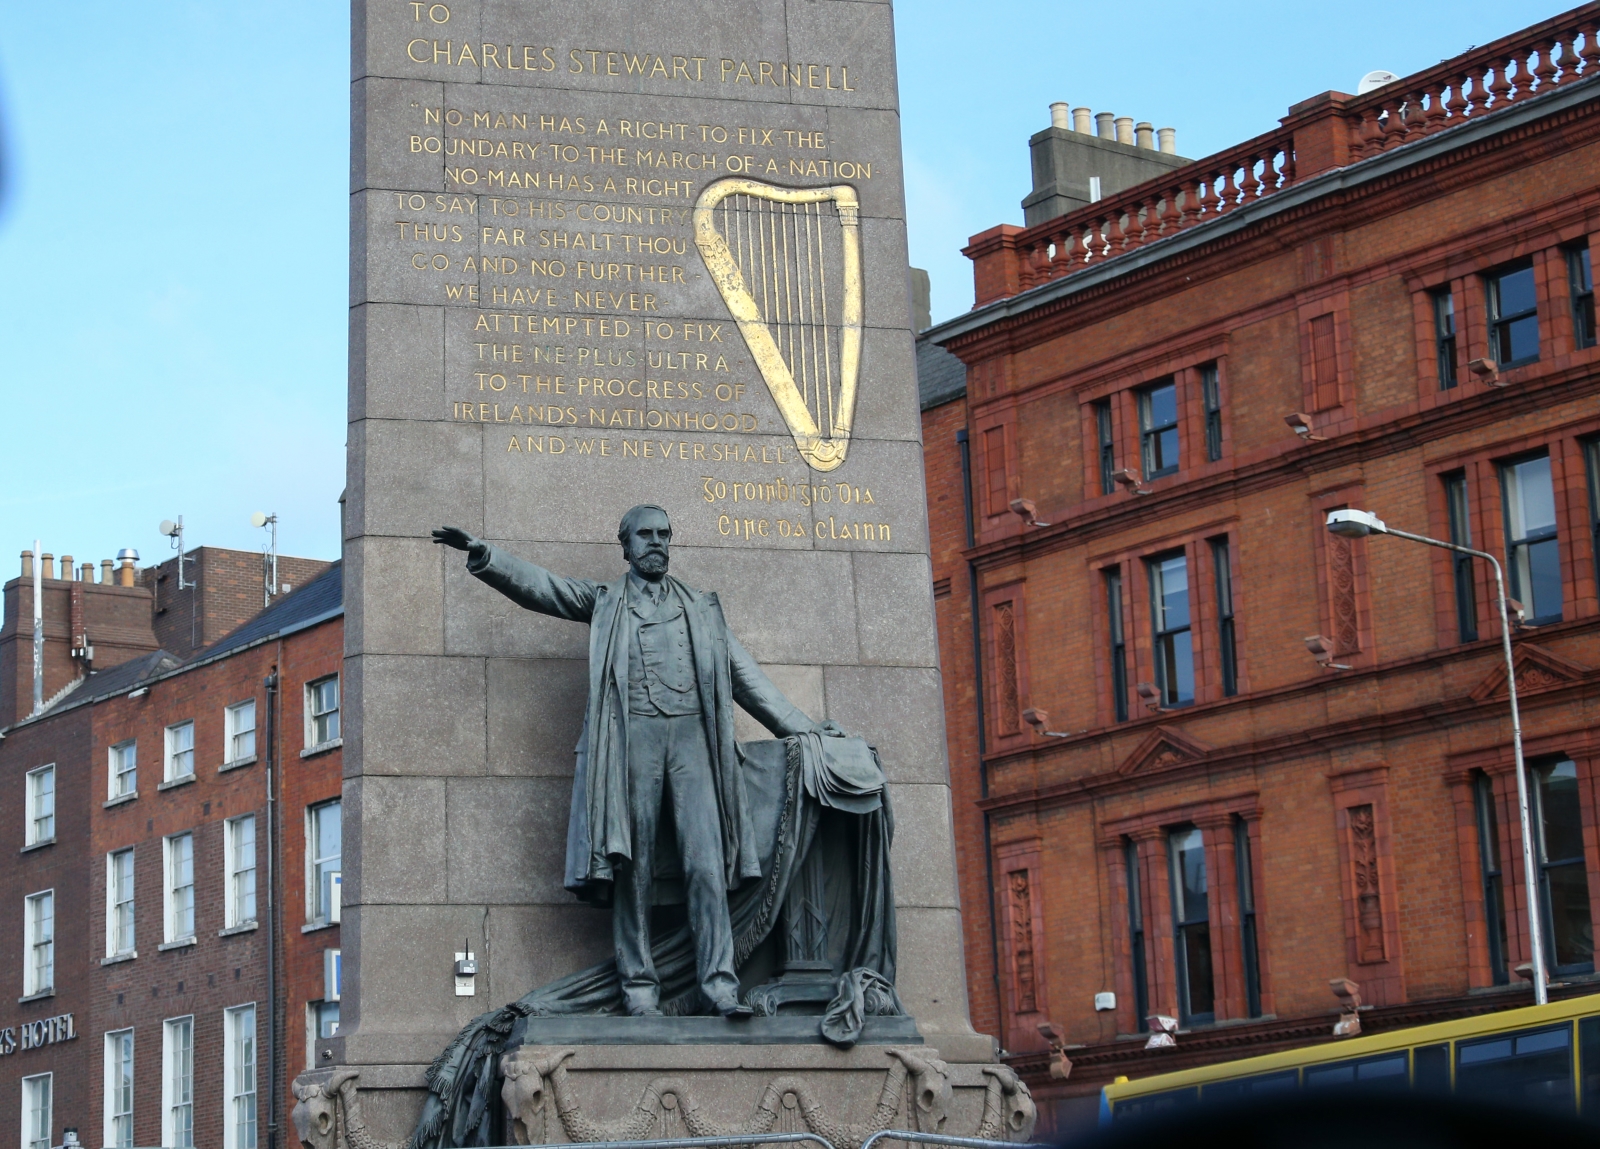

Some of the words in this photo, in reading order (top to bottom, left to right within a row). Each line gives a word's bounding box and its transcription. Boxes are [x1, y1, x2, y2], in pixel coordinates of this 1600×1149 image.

[409, 2, 450, 24] TO
[407, 38, 556, 72] CHARLES
[569, 49, 706, 82] STEWART
[721, 58, 856, 92] PARNELL
[473, 111, 527, 130] MAN
[540, 115, 586, 134] HAS
[597, 119, 610, 136] A
[620, 120, 688, 141] RIGHT
[699, 125, 728, 143] TO
[738, 127, 774, 146] FIX
[784, 130, 826, 149] THE
[410, 135, 540, 160] BOUNDARY
[550, 144, 579, 162] TO
[586, 146, 628, 166] THE
[637, 149, 716, 171] MARCH
[726, 155, 754, 173] OF
[766, 158, 779, 175] A
[789, 159, 872, 179] NATION
[445, 167, 478, 185] NO
[488, 170, 540, 188] MAN
[549, 173, 594, 192] HAS
[604, 176, 617, 193] A
[626, 177, 694, 199] RIGHT
[395, 193, 425, 211] TO
[435, 195, 477, 214] SAY
[489, 198, 519, 216] TO
[529, 201, 566, 219] HIS
[576, 203, 688, 226] COUNTRY
[395, 221, 462, 242] THUS
[483, 226, 526, 246] FAR
[540, 230, 614, 251] SHALT
[621, 234, 686, 254] THOU
[412, 253, 449, 271] GO
[463, 256, 518, 275] AND
[531, 258, 565, 277] NO
[577, 260, 686, 285] FURTHER
[445, 283, 479, 302] WE
[493, 285, 557, 306] HAVE
[575, 289, 658, 311] NEVER
[474, 314, 630, 338] ATTEMPTED
[642, 321, 674, 339] TO
[684, 323, 723, 342] FIX
[474, 342, 523, 363] THE
[534, 344, 566, 364] NE
[578, 347, 636, 367] PLUS
[649, 351, 730, 372] ULTRA
[474, 372, 507, 391] TO
[517, 374, 566, 394] THE
[578, 377, 703, 400] PROGRESS
[715, 383, 745, 402] OF
[453, 402, 578, 425] IRELANDS
[589, 407, 758, 432] NATIONHOOD
[507, 435, 566, 454] AND
[574, 438, 611, 457] WE
[623, 439, 707, 461] NEVER
[21, 1013, 79, 1050] HOTEL
